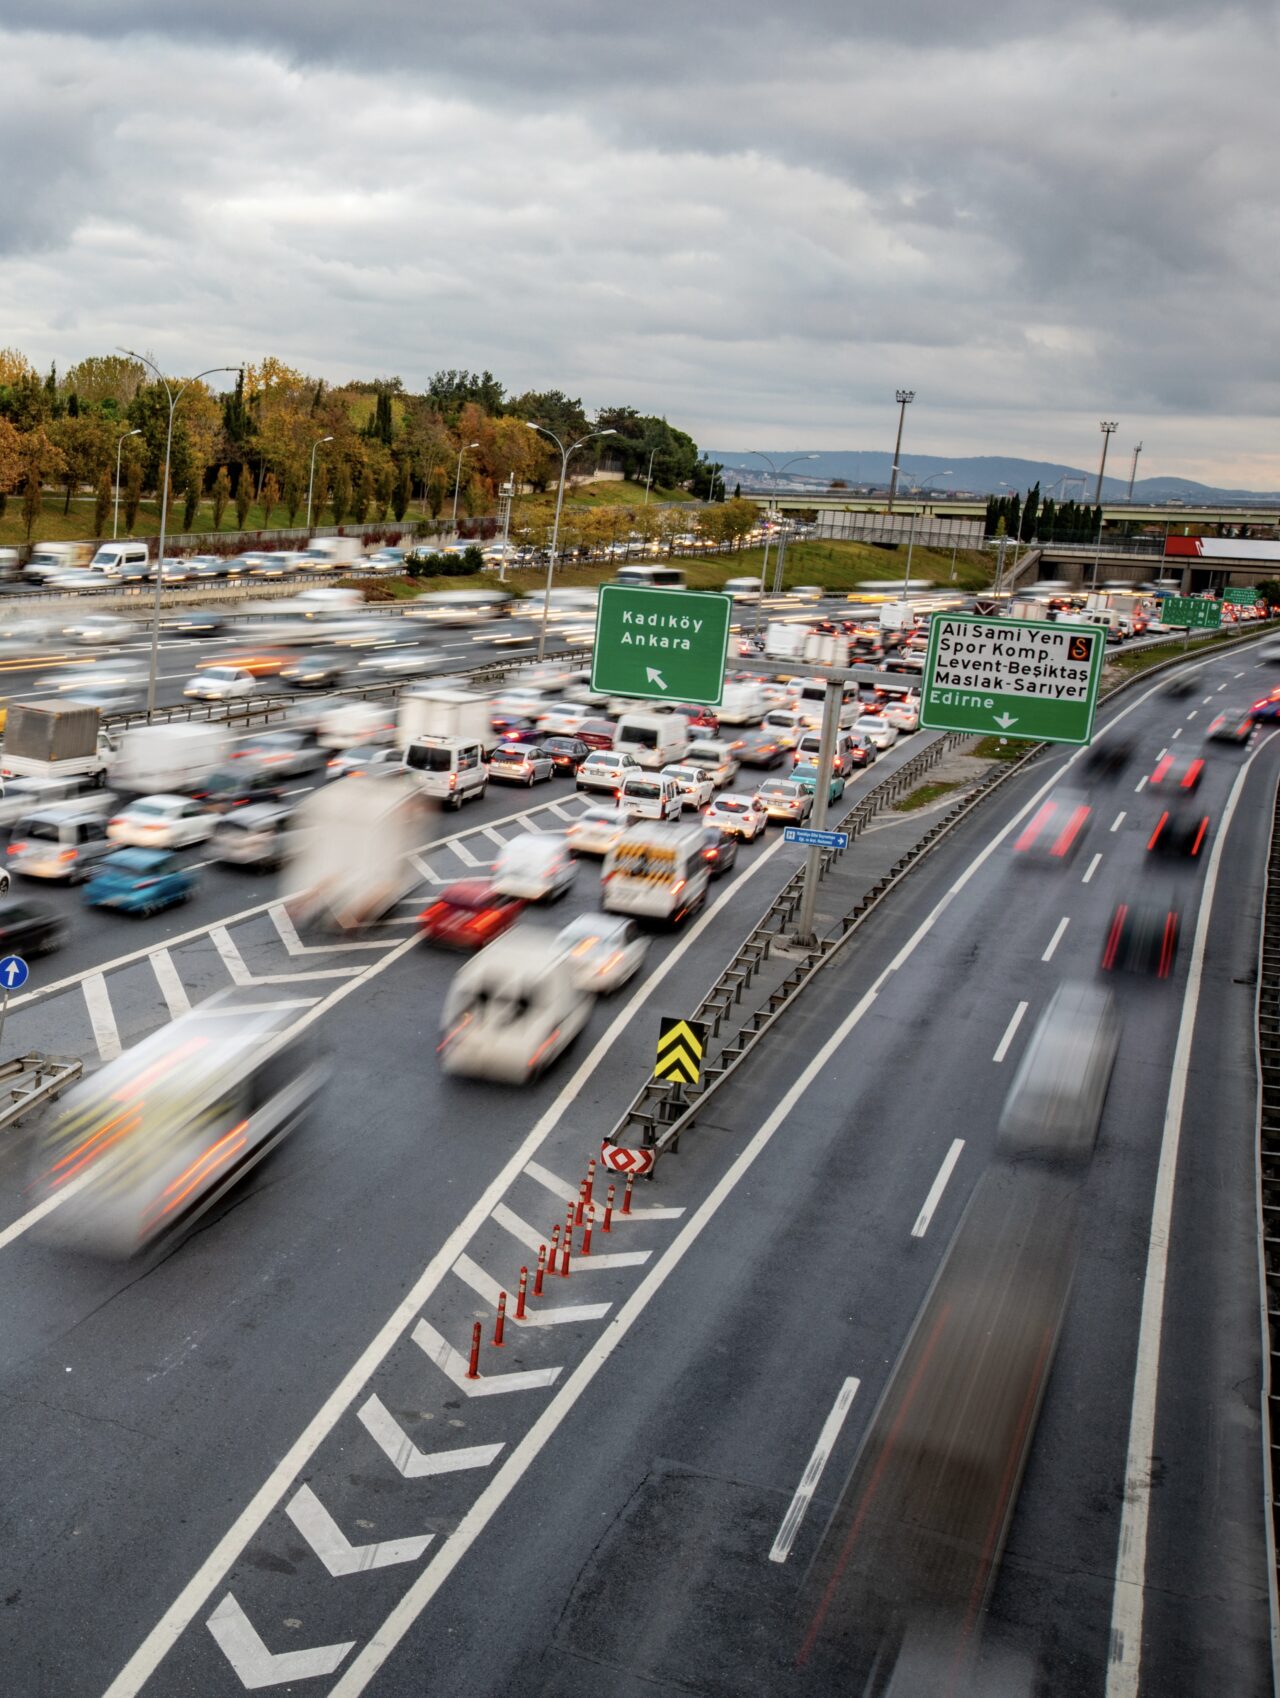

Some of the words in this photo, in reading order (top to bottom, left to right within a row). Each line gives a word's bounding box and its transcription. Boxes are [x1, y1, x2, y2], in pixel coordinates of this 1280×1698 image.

[622, 611, 704, 633] Kadıköy
[621, 632, 691, 650] Ankara
[942, 623, 967, 637] Ali
[972, 625, 1021, 642] Sami
[1028, 630, 1064, 646] Yen
[940, 638, 986, 655] Spor
[992, 643, 1054, 663] Komp.
[937, 655, 1088, 682] Levent-Beşiktaş
[935, 672, 1087, 698] Maslak-Sarıyer
[929, 690, 995, 709] Edirne
